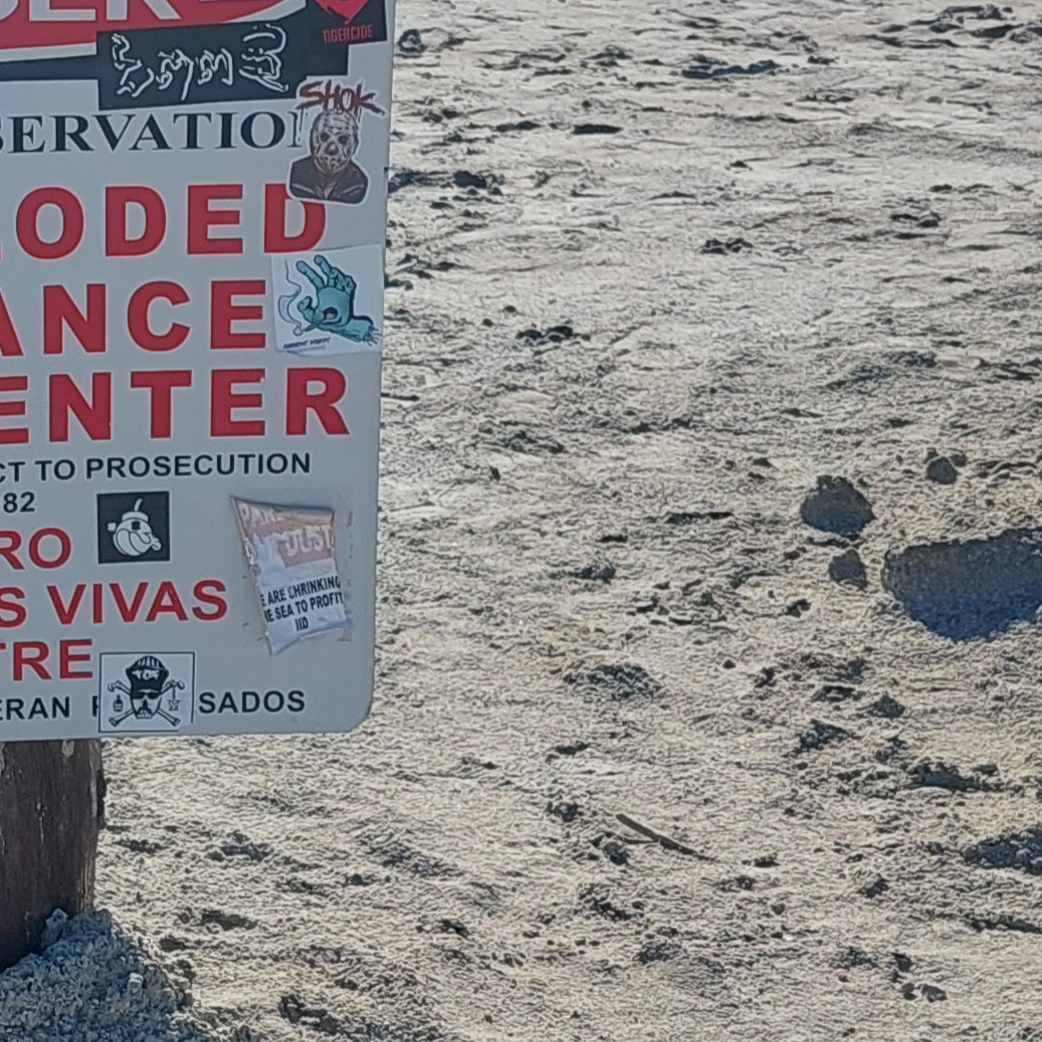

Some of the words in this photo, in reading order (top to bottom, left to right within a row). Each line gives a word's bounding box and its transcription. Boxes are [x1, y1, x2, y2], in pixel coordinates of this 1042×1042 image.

[321, 25, 374, 44] TIGERCIDE
[296, 79, 385, 117] SHOK
[35, 459, 76, 481] TO
[86, 453, 311, 480] PROSECUTION
[47, 579, 228, 625] VIVAS
[268, 588, 287, 604] ARE
[275, 605, 294, 620] SEA
[295, 601, 308, 615] TO
[310, 592, 344, 610] PROFIT
